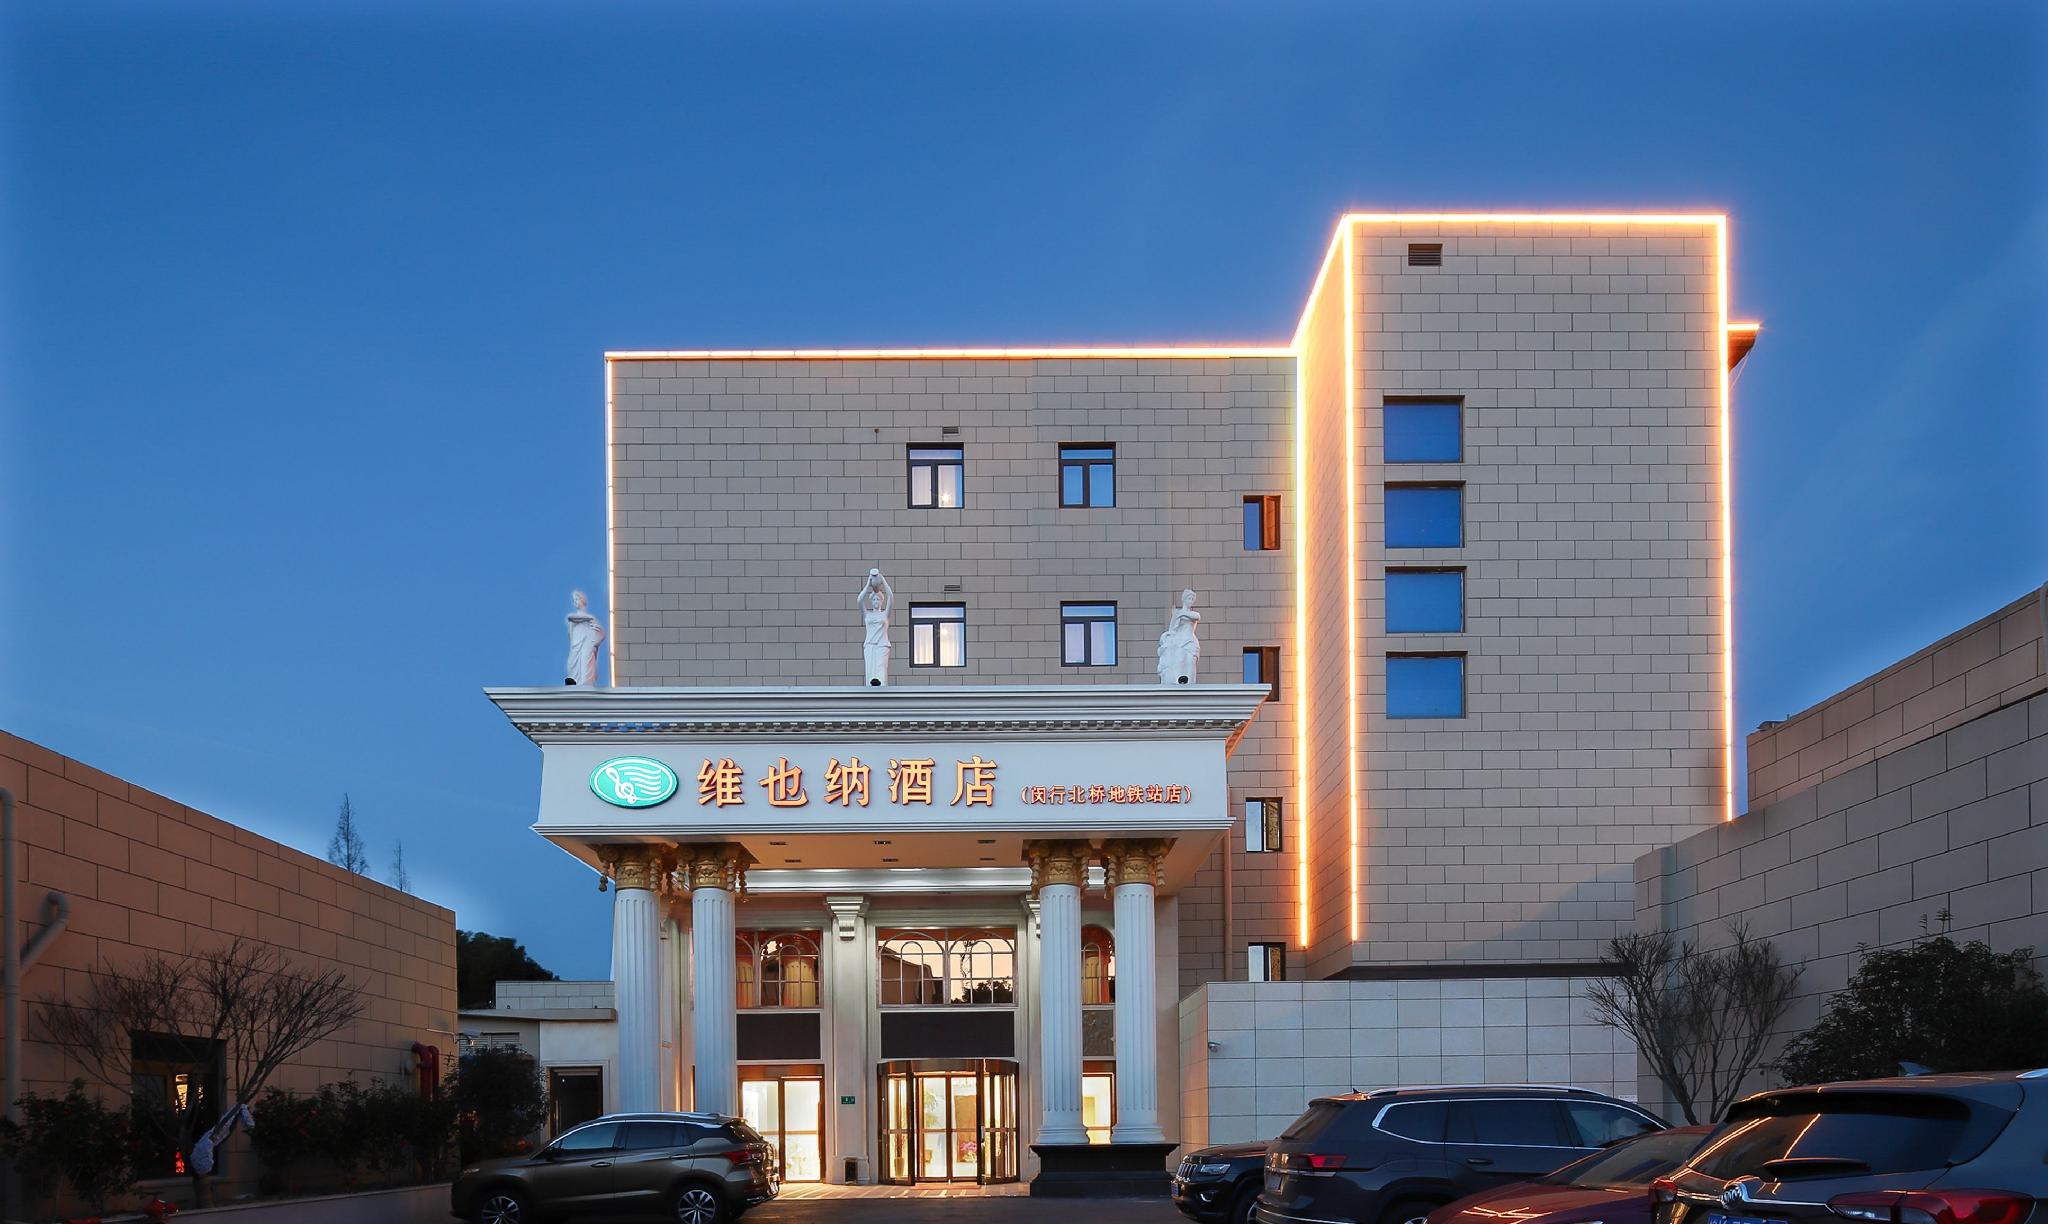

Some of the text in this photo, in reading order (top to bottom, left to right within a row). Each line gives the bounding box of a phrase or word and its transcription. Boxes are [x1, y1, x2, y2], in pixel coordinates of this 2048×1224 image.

[696, 755, 997, 807] 维也纳酒店
